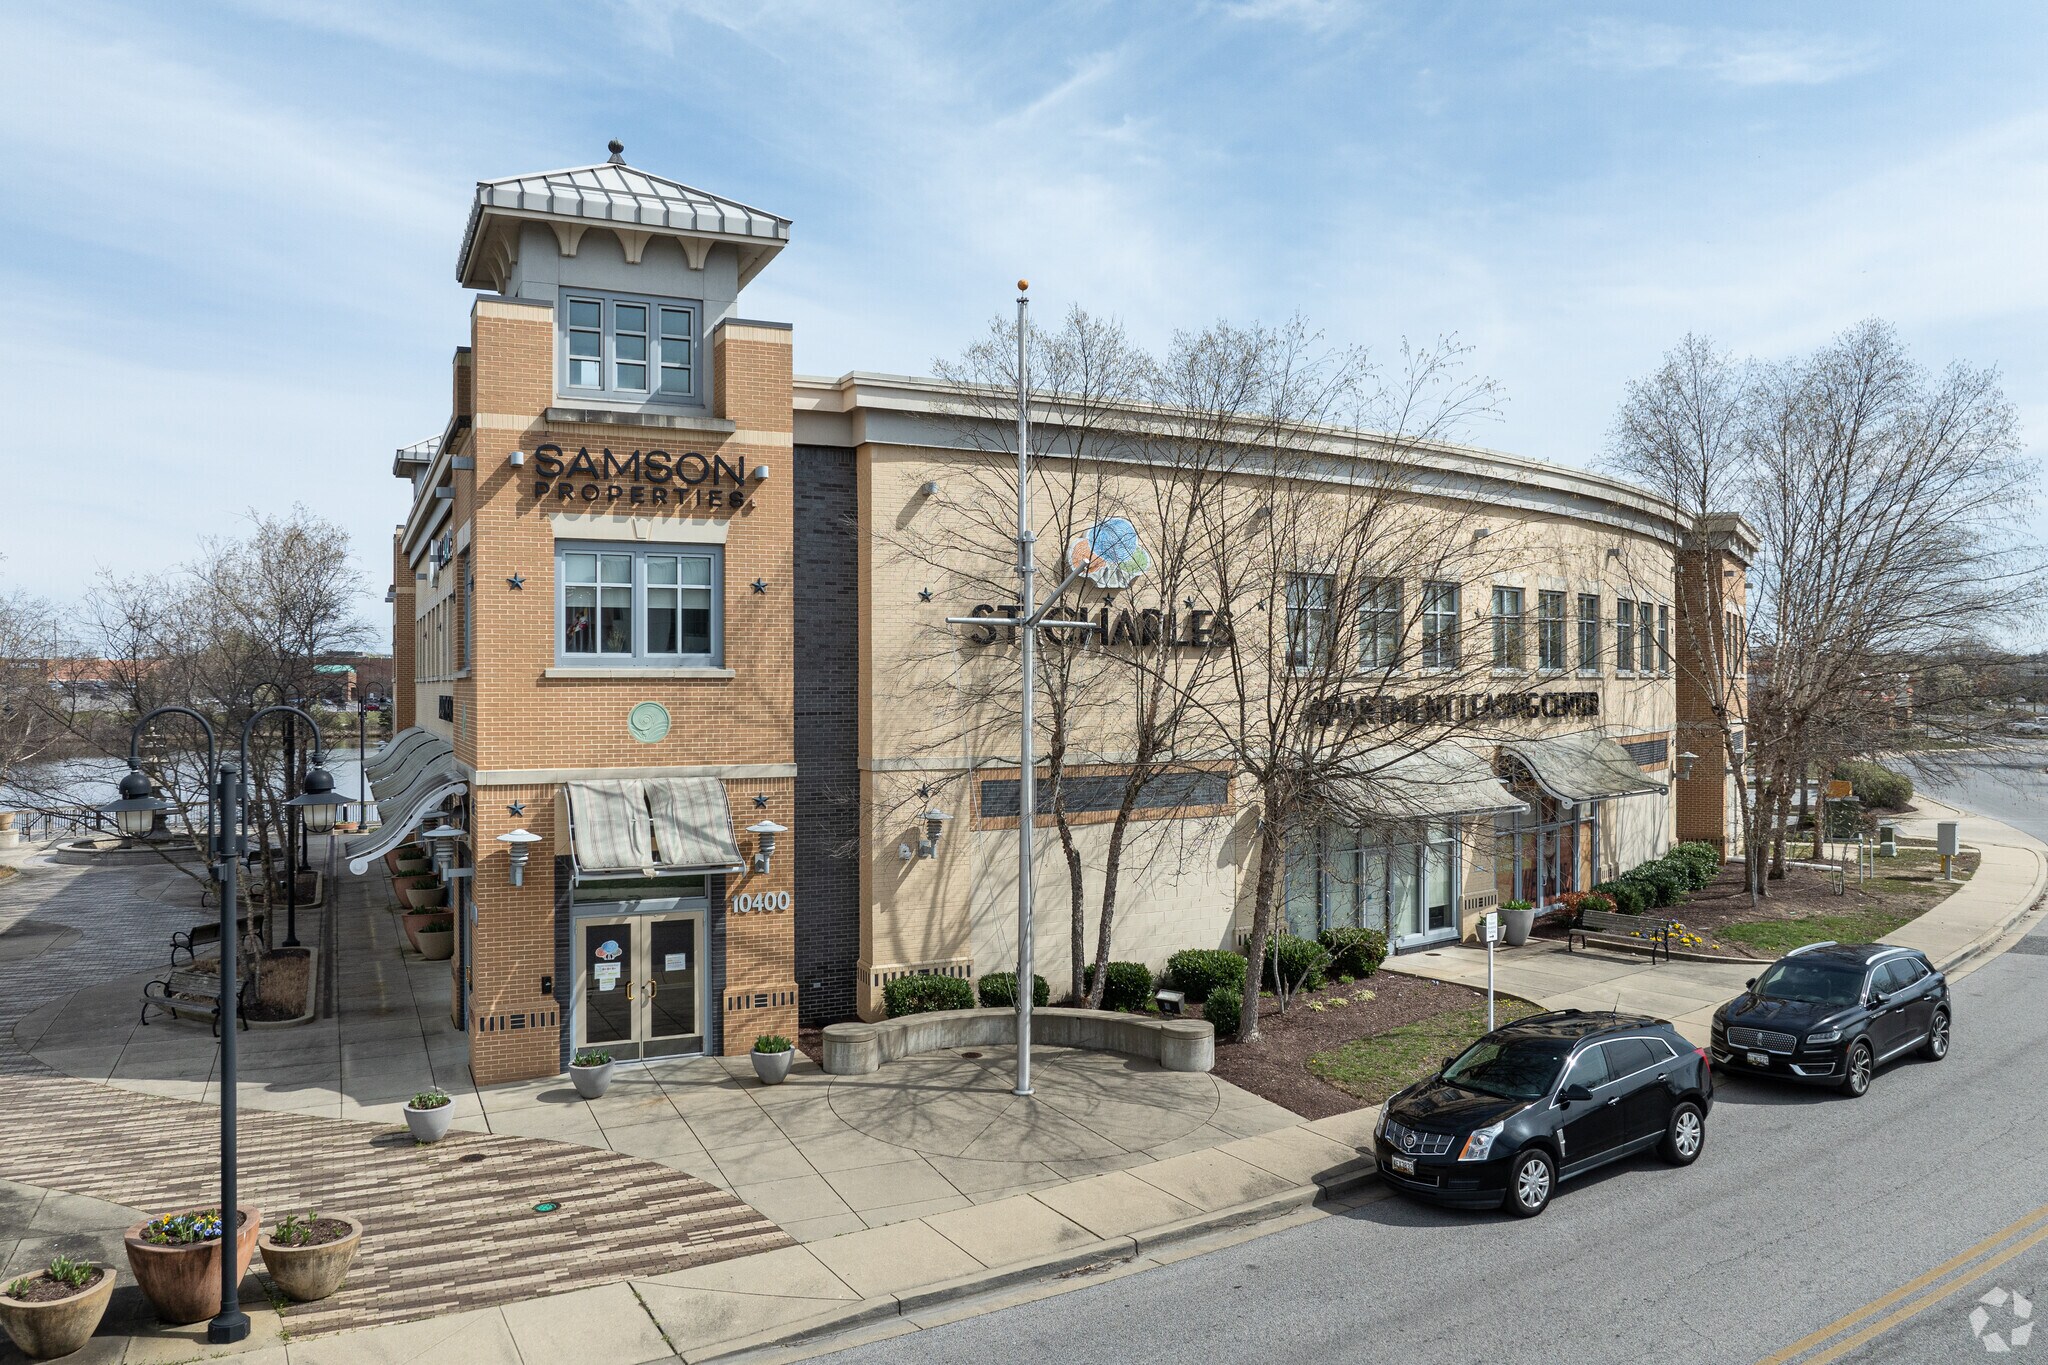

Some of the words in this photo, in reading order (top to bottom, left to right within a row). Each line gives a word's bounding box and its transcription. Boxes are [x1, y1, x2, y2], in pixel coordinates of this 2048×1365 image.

[534, 444, 745, 487] SAMSON
[534, 481, 745, 508] PROPERTIES
[731, 890, 791, 914] 10400
